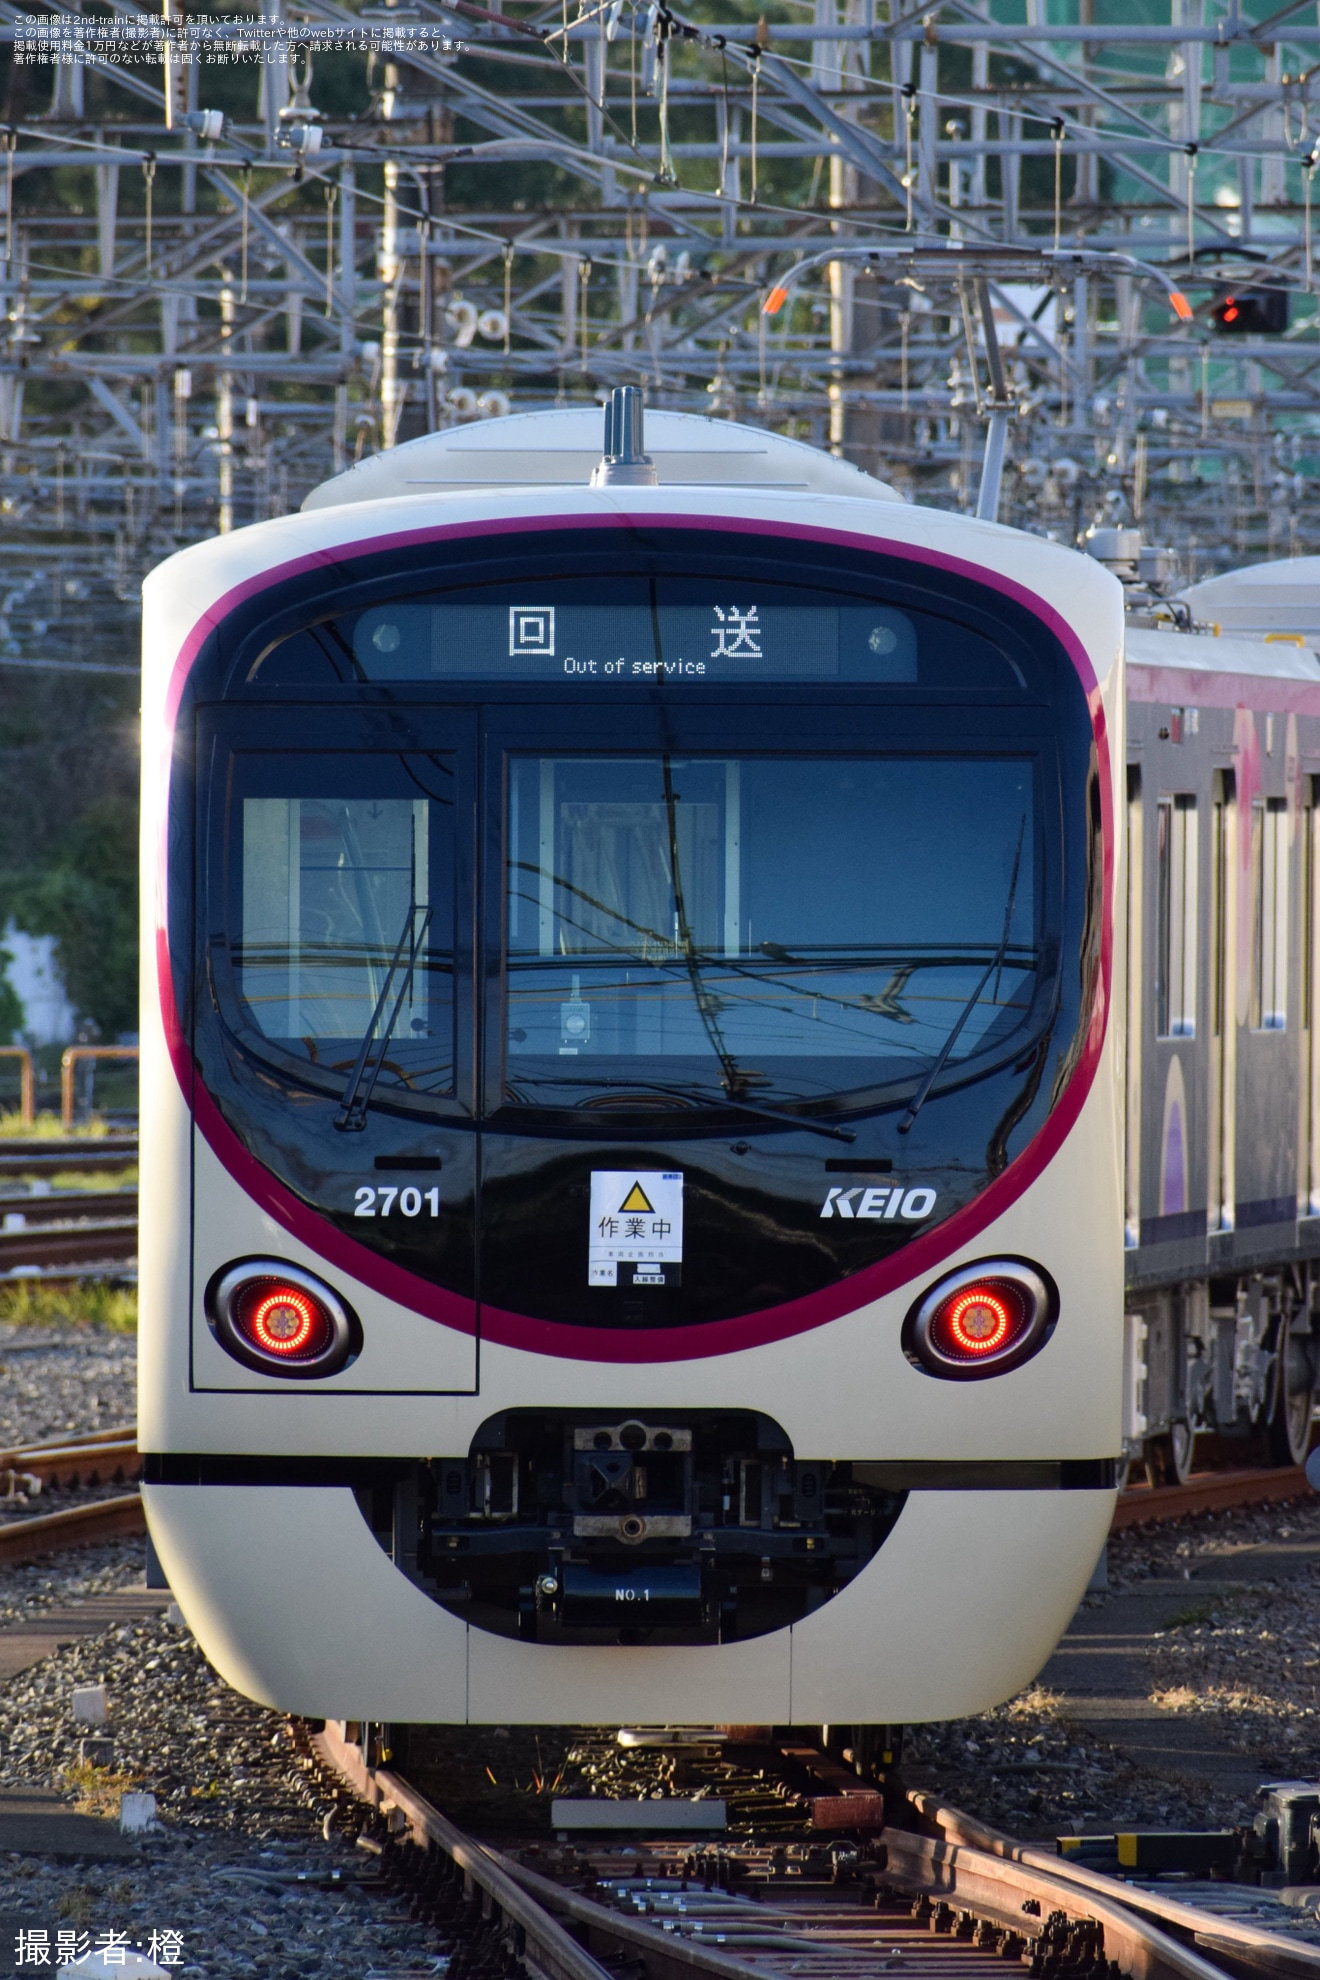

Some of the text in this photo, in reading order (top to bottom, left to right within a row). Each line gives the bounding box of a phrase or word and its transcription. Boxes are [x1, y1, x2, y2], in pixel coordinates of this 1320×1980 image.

[563, 657, 706, 674] Out of service
[353, 1186, 439, 1217] 2701
[820, 1187, 937, 1217] KEIO
[598, 1217, 671, 1240] 作業中
[615, 1588, 650, 1602] NO.1
